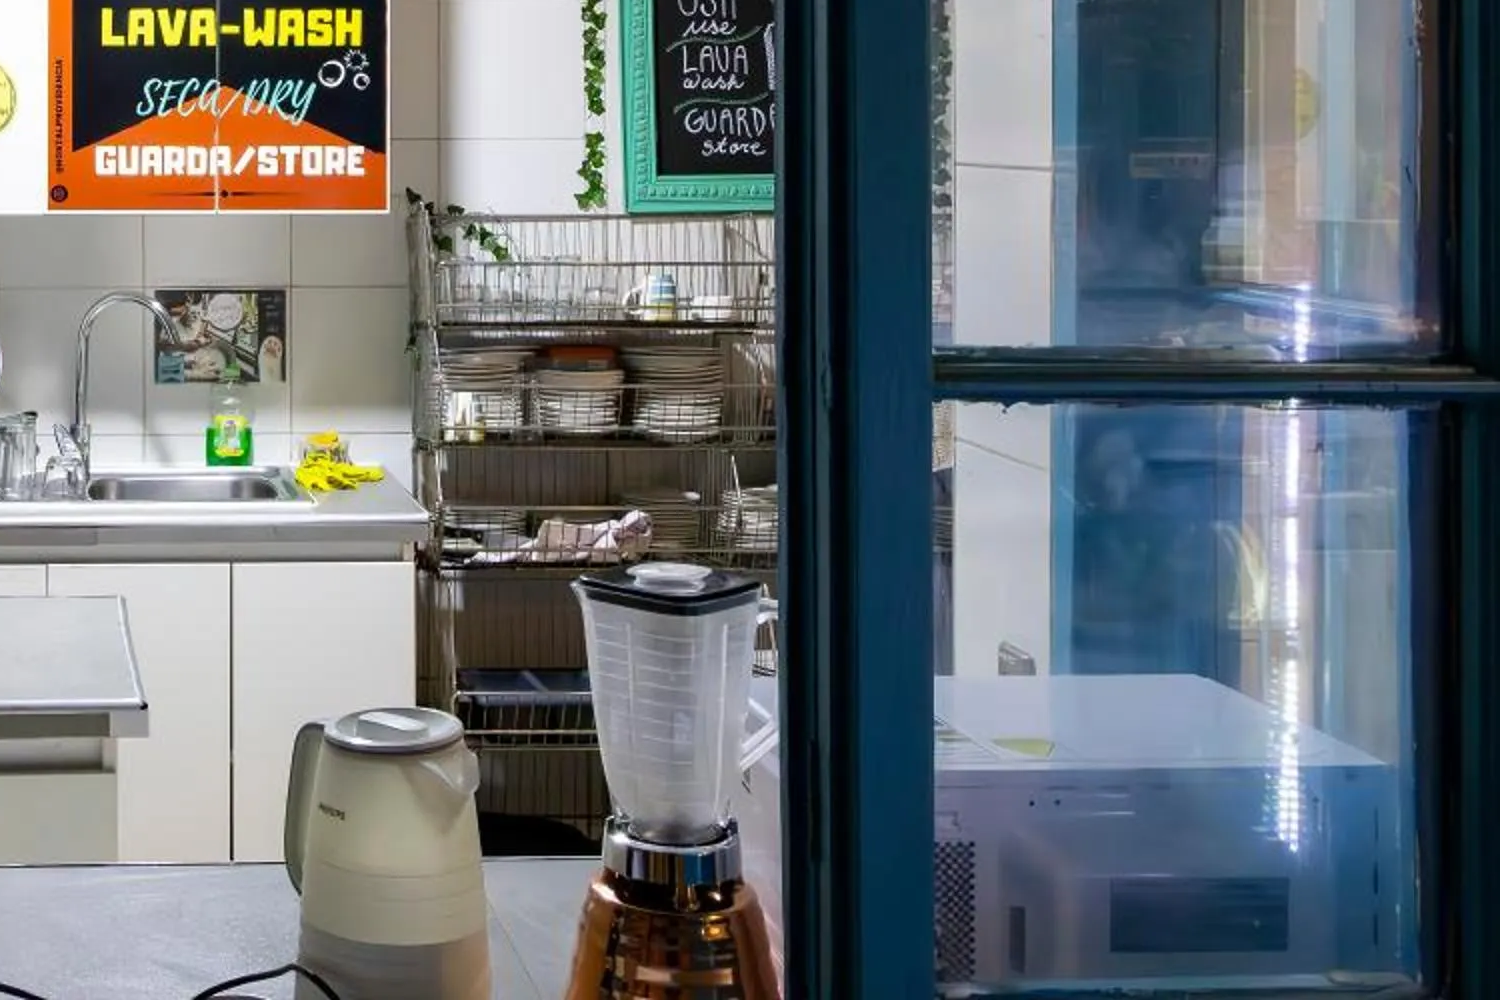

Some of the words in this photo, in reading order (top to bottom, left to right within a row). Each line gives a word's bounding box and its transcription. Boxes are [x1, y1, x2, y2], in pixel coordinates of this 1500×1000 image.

[100, 8, 364, 48] LAVA-WASH
[682, 18, 737, 37] use
[682, 44, 750, 77] LAVA
[682, 76, 745, 91] wash
[700, 138, 767, 156] store
[94, 145, 366, 177] GUARDA/STORE
